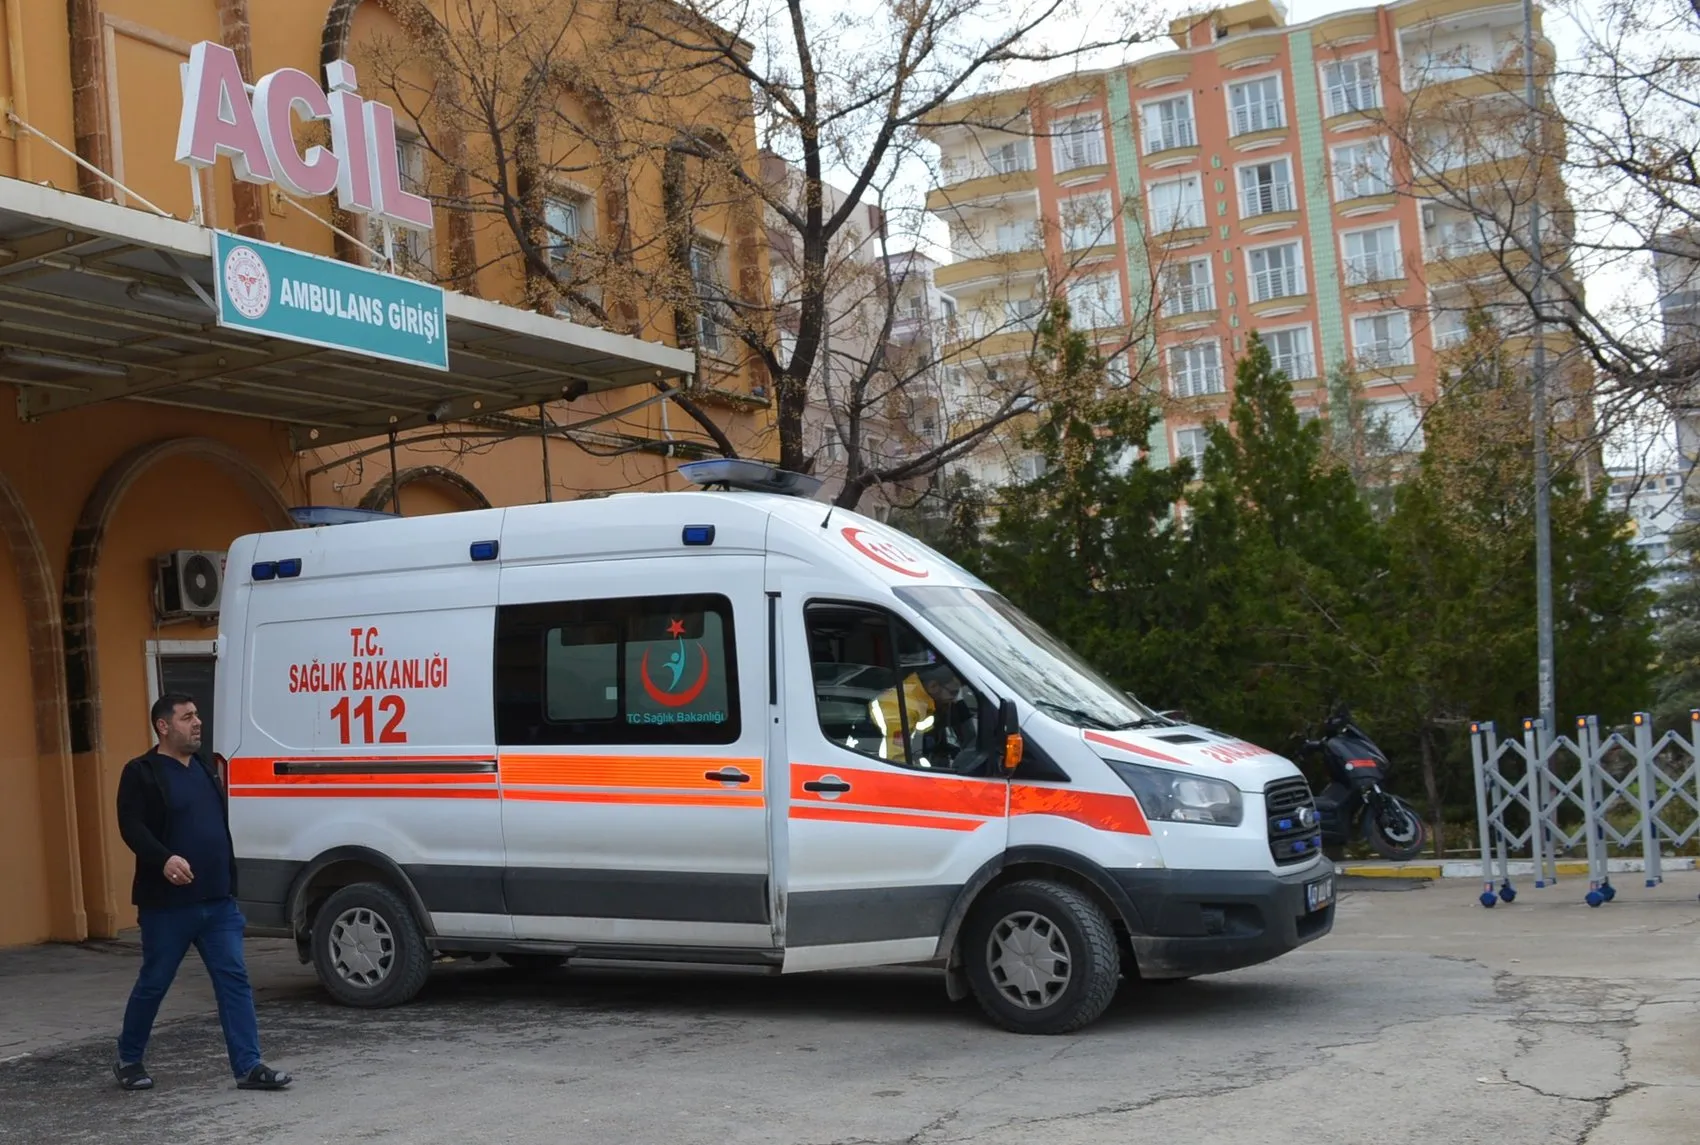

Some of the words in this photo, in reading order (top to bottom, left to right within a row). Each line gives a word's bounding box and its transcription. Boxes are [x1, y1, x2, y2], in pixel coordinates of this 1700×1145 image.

[175, 40, 434, 232] ACİL
[280, 277, 383, 326] AMBULANS
[388, 299, 439, 344] GİRİŞİ
[350, 627, 384, 657] T.C.
[289, 658, 347, 693] SAĞLIK
[353, 652, 448, 691] BAKANLIĞI
[330, 694, 407, 744] 112
[627, 714, 641, 724] TC
[643, 712, 674, 725] Sağlık
[677, 711, 724, 724] Bakanlığı
